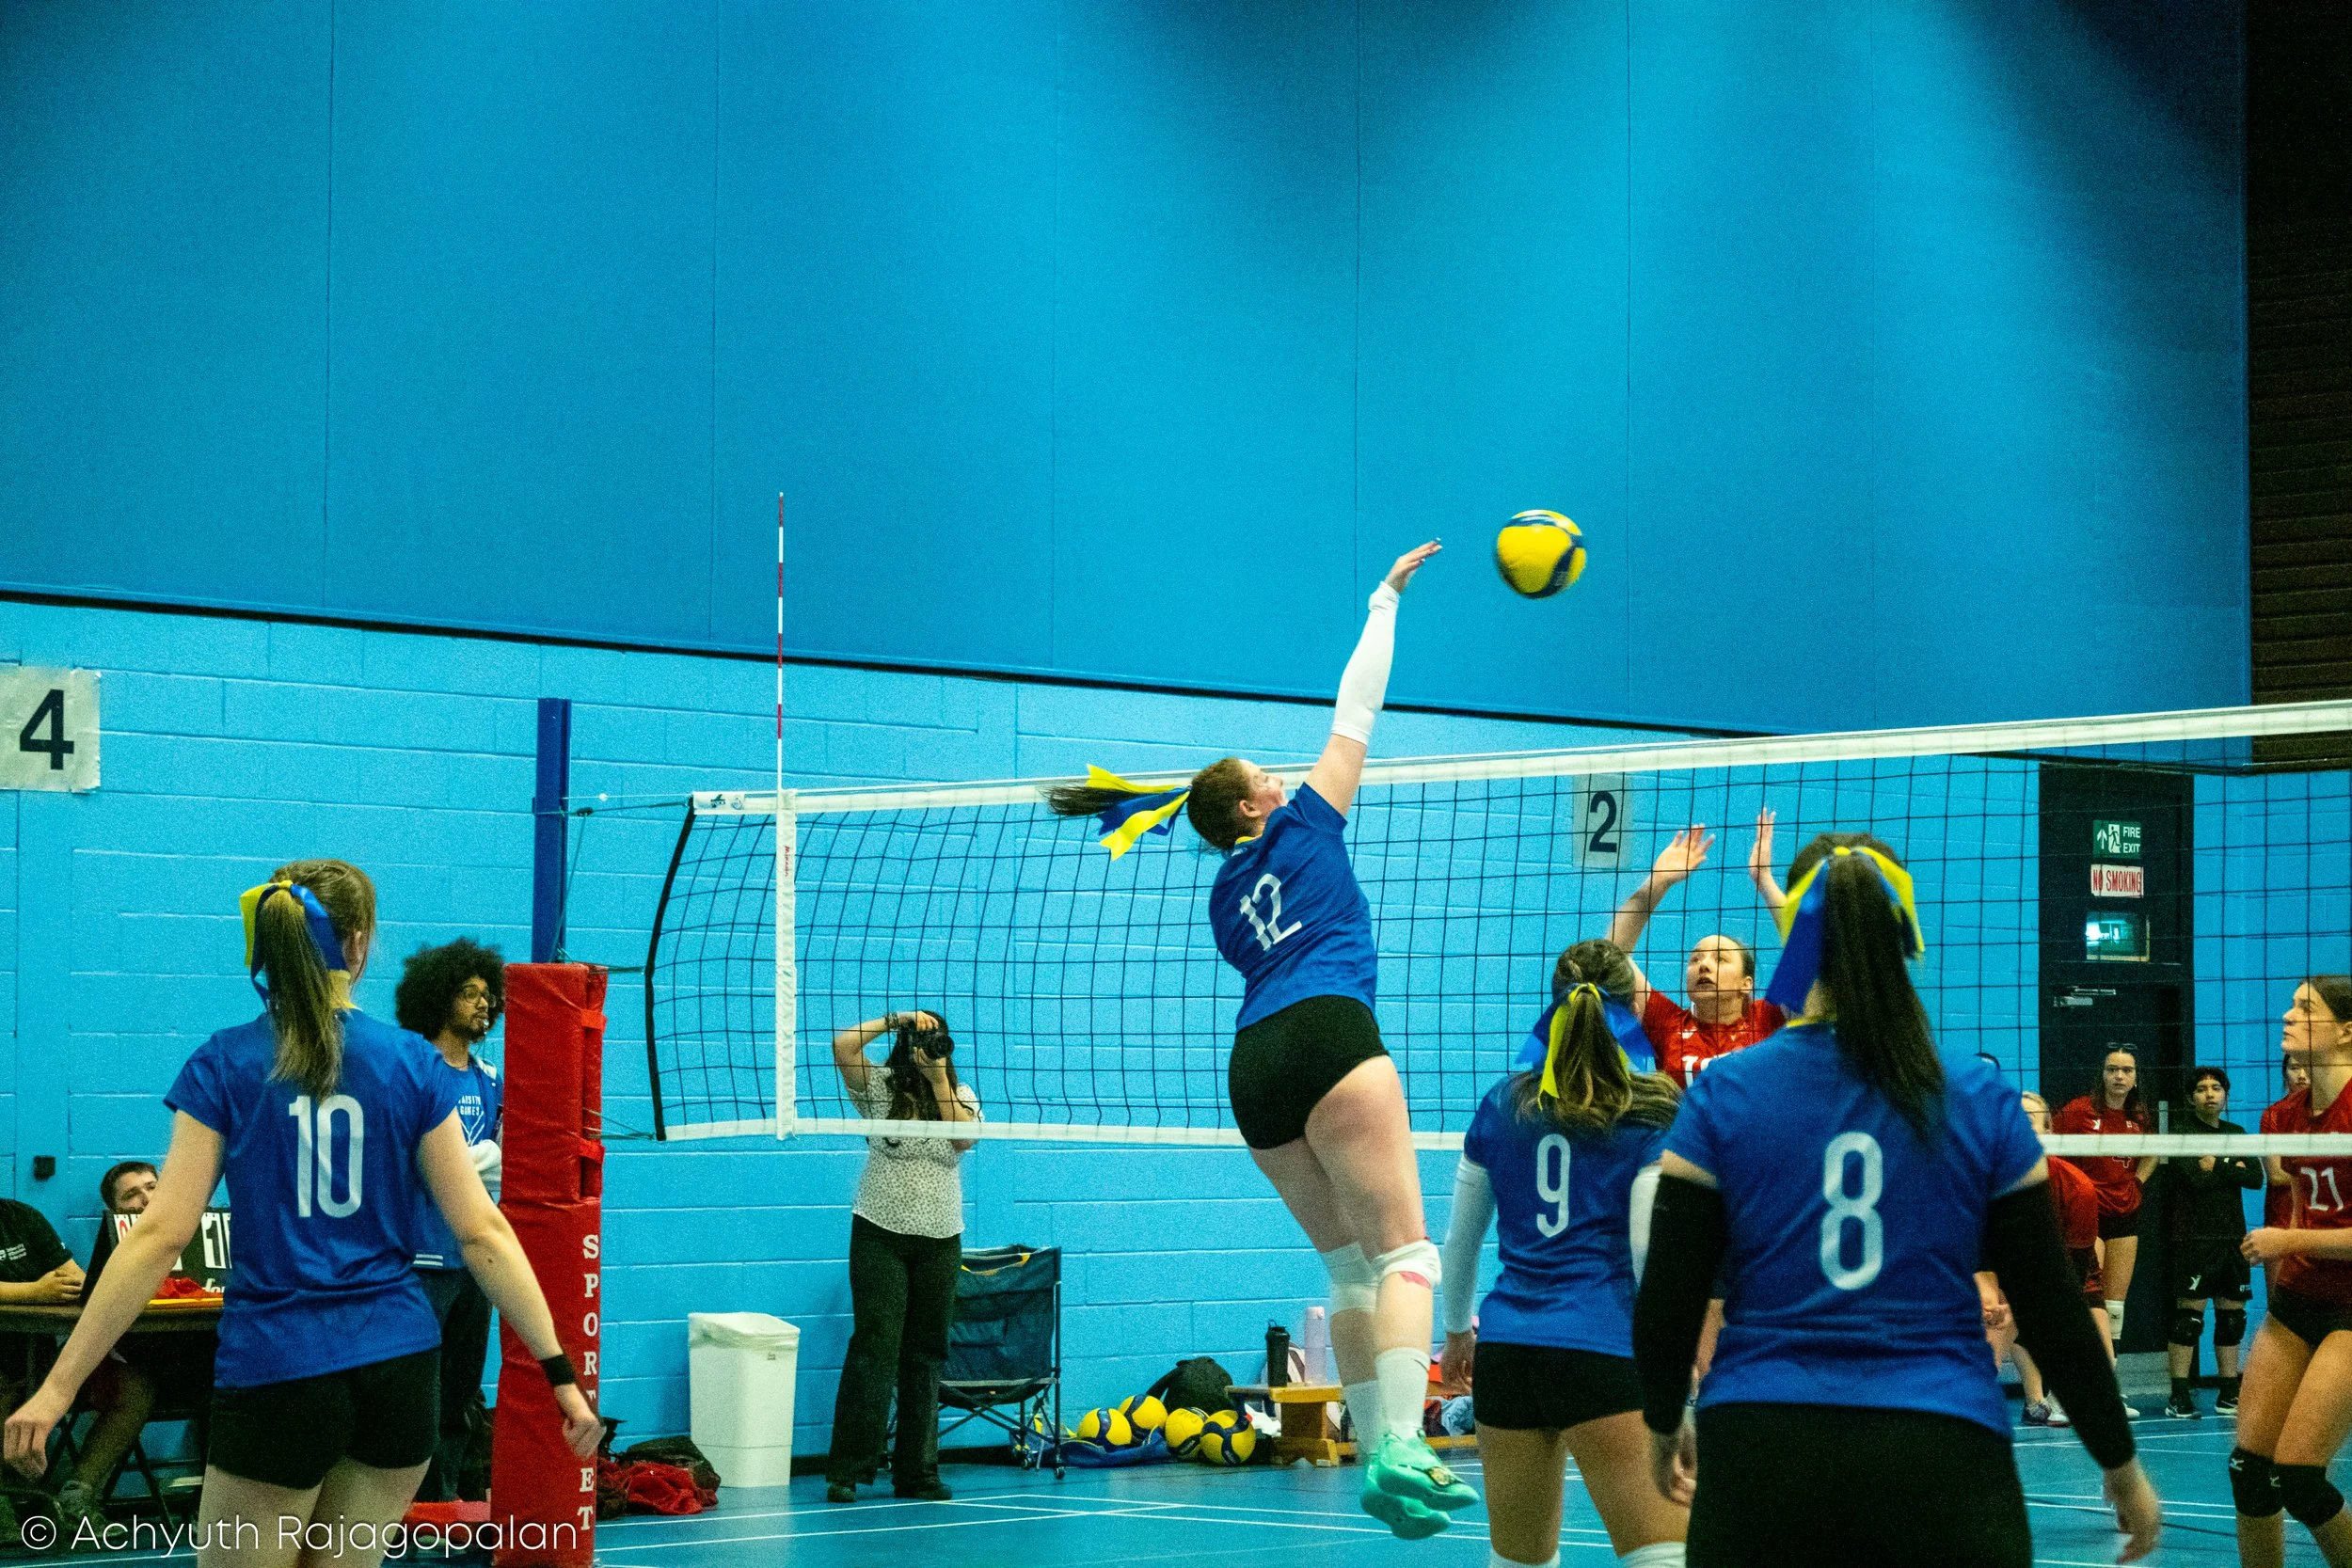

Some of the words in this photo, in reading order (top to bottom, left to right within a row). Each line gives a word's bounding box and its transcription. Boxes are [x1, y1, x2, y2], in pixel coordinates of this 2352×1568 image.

[20, 689, 74, 770] 4
[1589, 791, 1617, 853] 2
[2122, 826, 2141, 839] FIRE
[2122, 843, 2141, 853] EXIT
[1239, 873, 1302, 951] 12
[2092, 869, 2104, 892] NO
[2106, 870, 2142, 893] SMOKING
[288, 1094, 364, 1218] 10
[1536, 1132, 1571, 1239] 9
[2300, 1166, 2344, 1212] 21
[1820, 1131, 1883, 1291] 8
